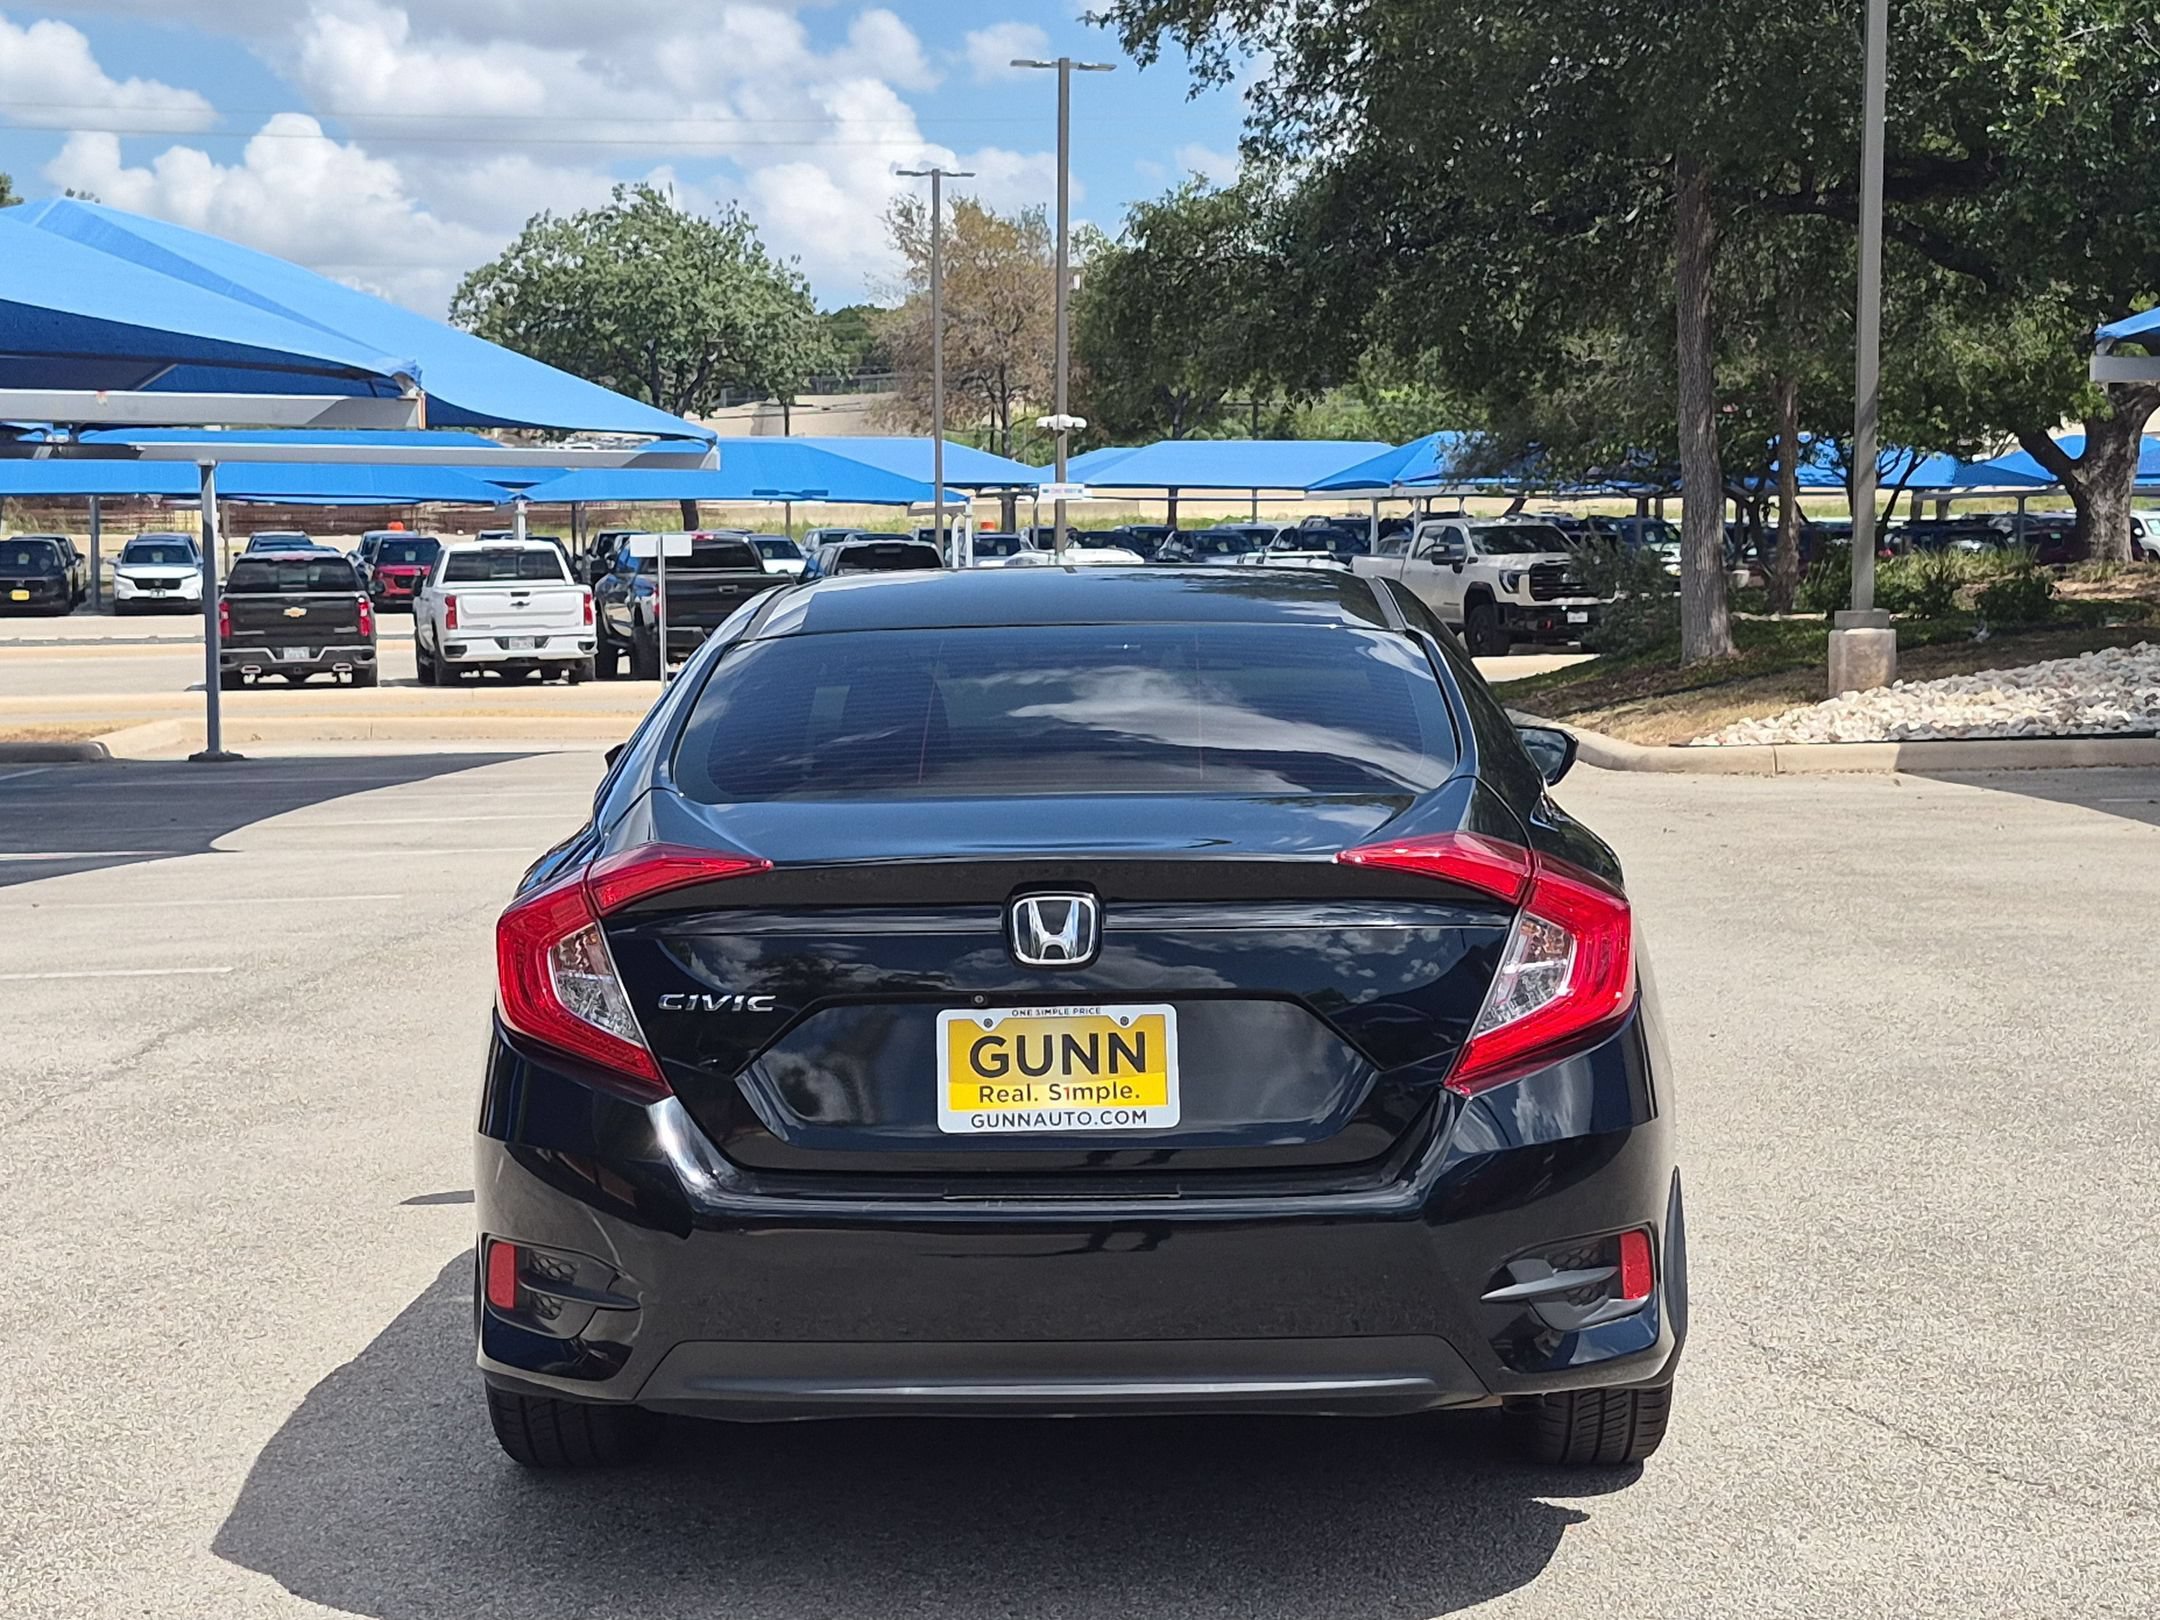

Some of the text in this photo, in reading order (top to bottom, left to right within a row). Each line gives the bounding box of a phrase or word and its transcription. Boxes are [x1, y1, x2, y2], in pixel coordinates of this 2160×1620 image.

[658, 993, 776, 1012] CIVIC
[1011, 1006, 1101, 1017] ONE SIMPLE PRICE
[969, 1031, 1147, 1079] GUNN
[979, 1083, 1039, 1104] Real.
[970, 1109, 1148, 1129] GUNNAUTO.COM
